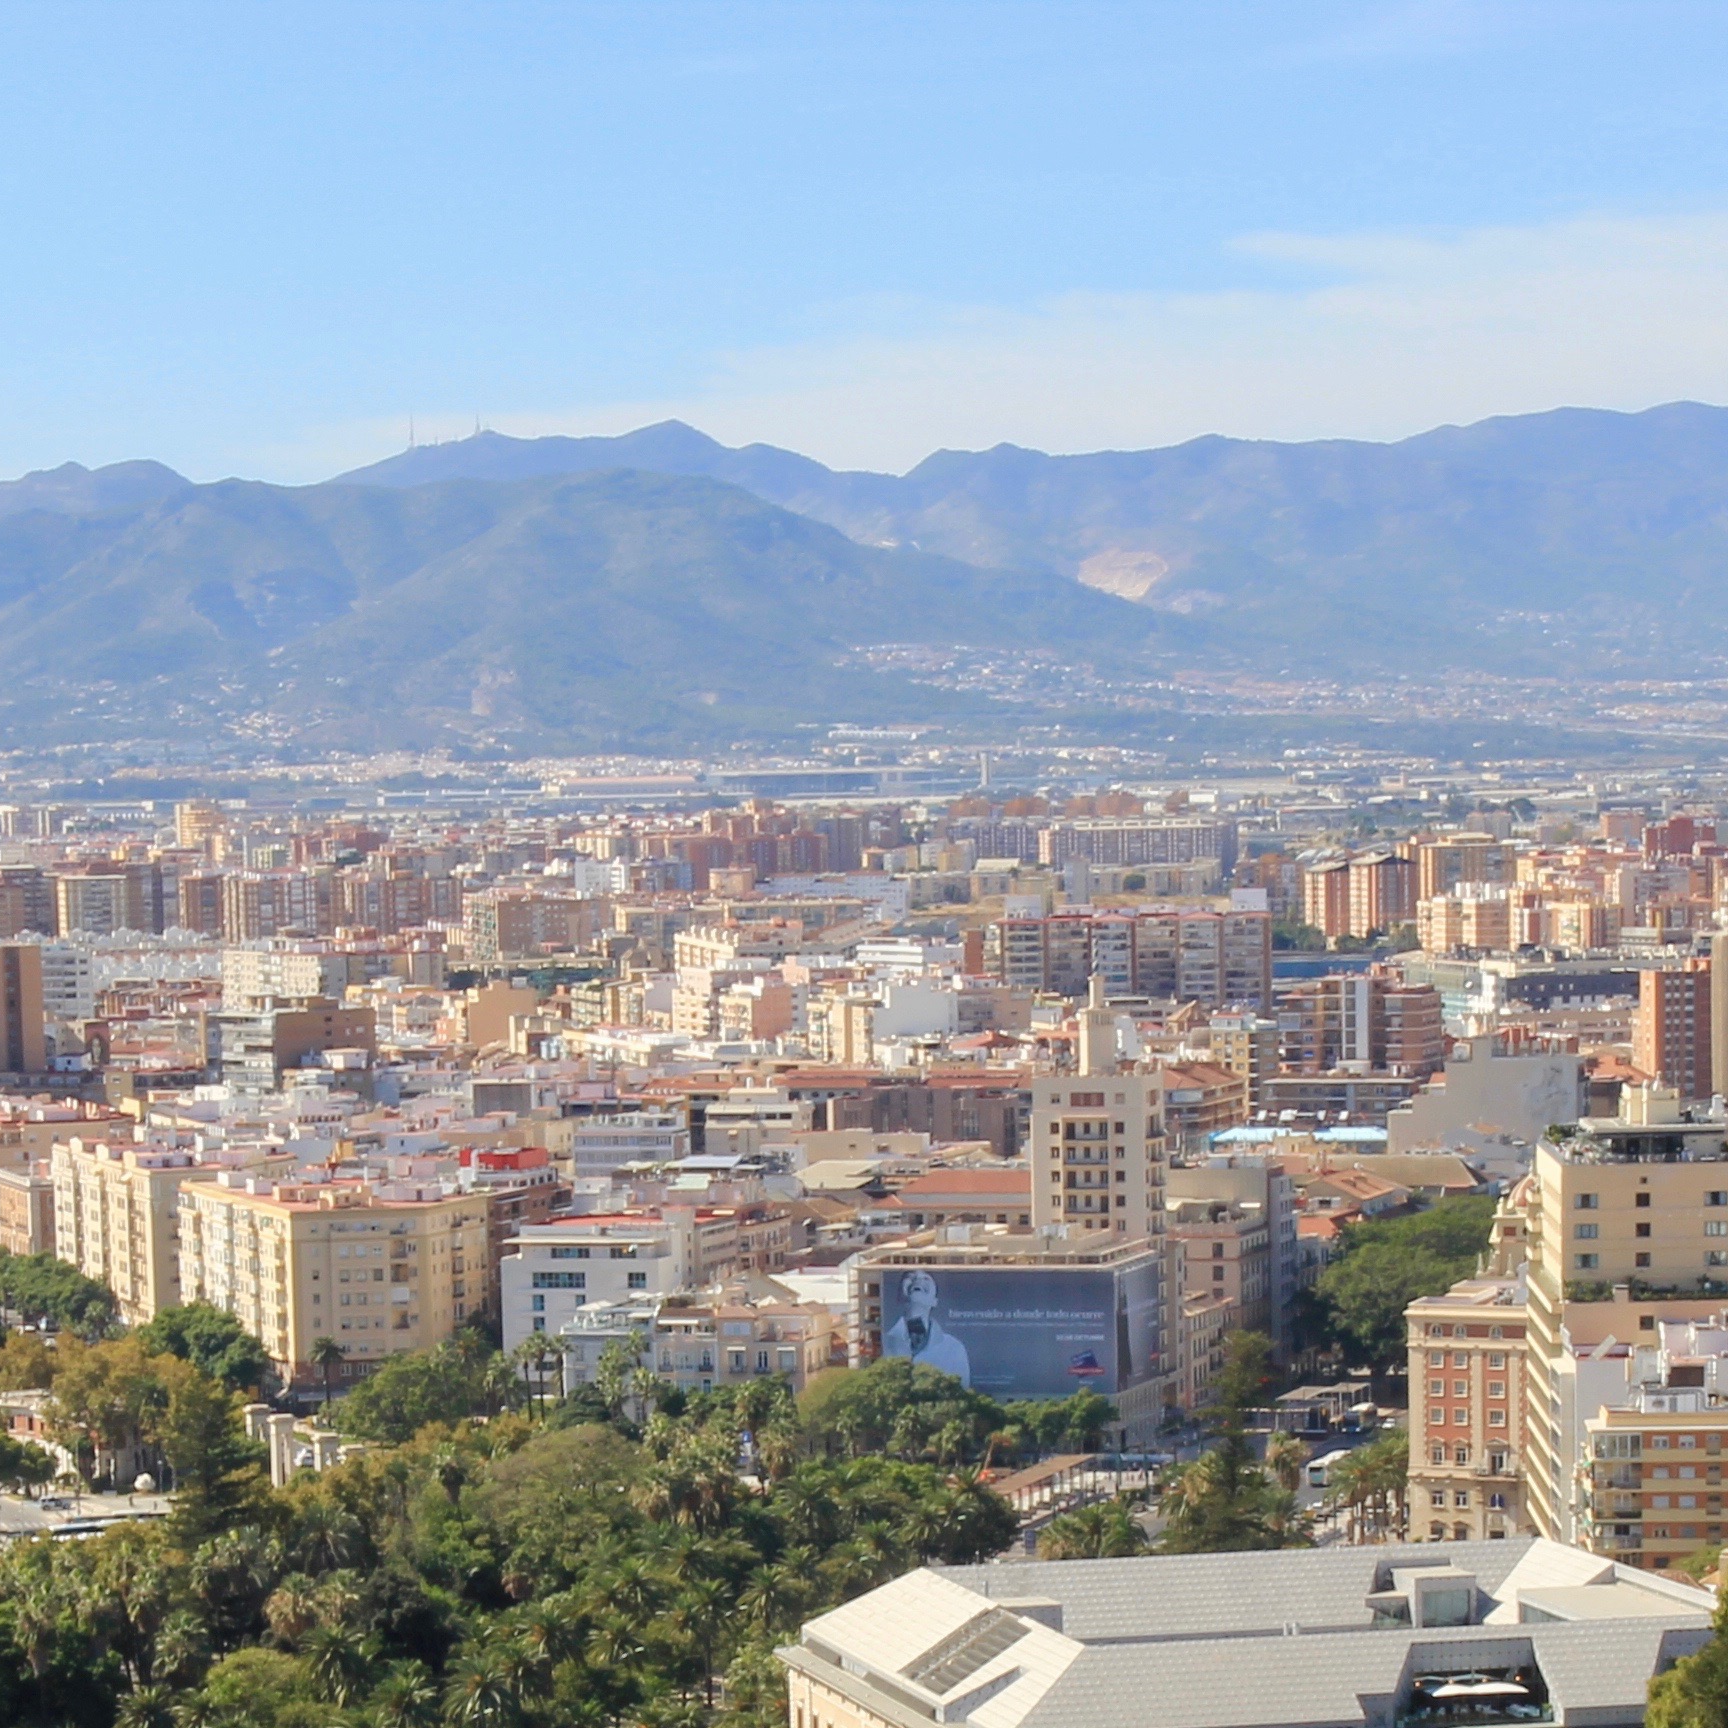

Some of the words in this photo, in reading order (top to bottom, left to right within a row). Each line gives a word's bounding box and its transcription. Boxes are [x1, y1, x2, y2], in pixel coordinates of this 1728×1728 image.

[949, 1308, 1003, 1318] bienvenido
[1014, 1308, 1045, 1318] donde
[1046, 1309, 1069, 1319] todo
[1070, 1311, 1105, 1319] ocurre
